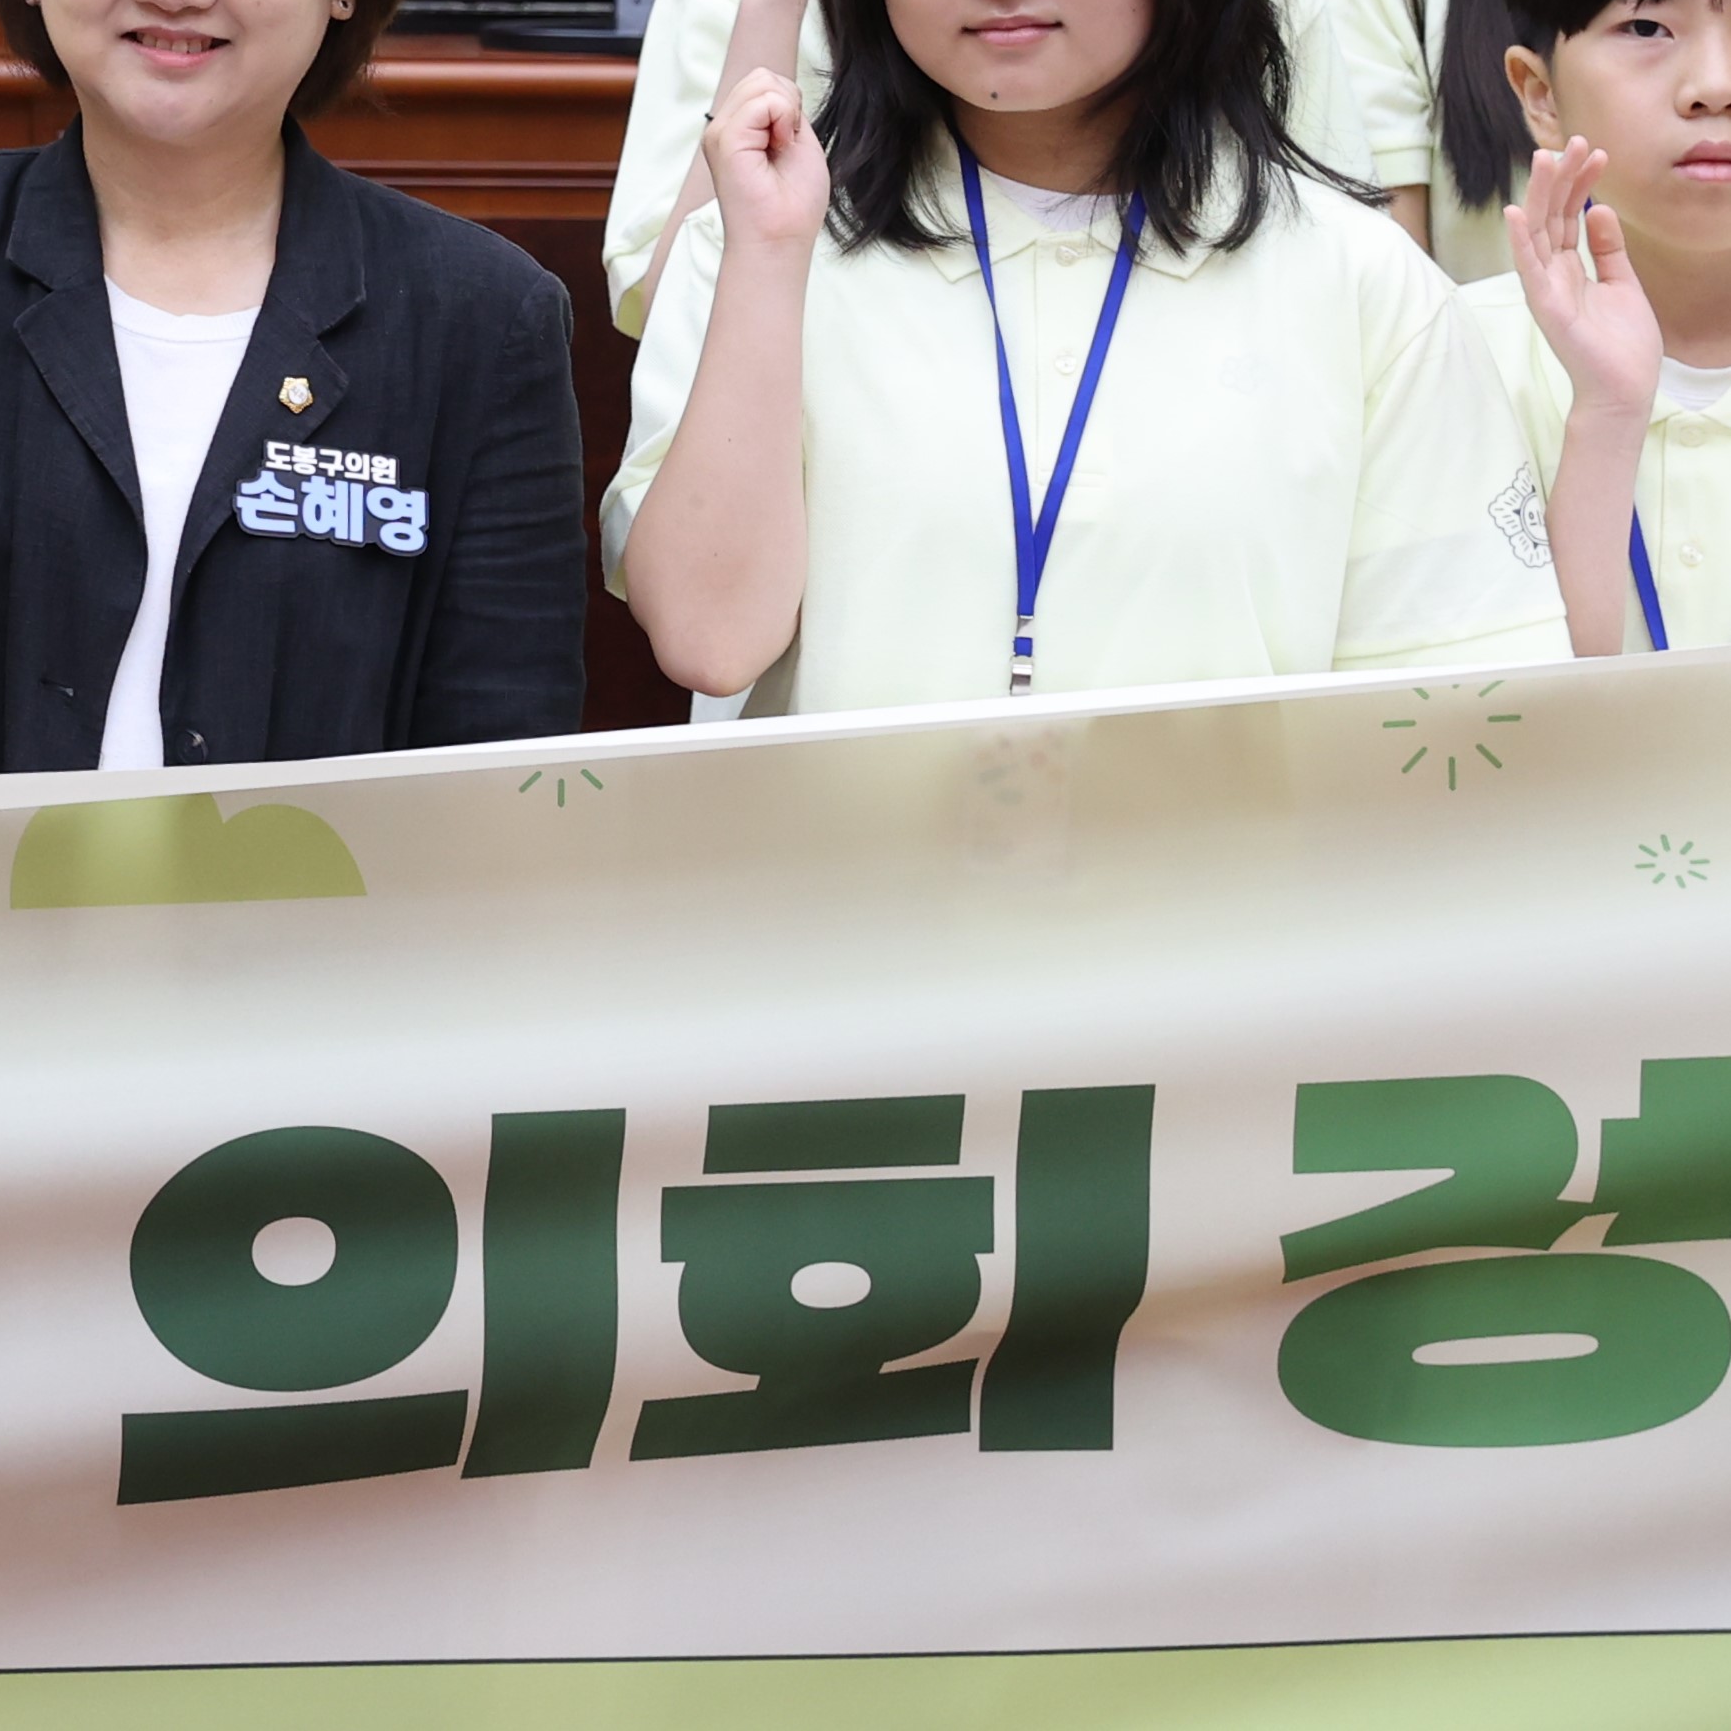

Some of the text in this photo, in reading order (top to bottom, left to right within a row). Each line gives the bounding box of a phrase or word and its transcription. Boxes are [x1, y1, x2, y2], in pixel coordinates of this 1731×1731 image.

[265, 440, 397, 485] 도봉구의원
[236, 470, 427, 553] 손혜영
[115, 1083, 1156, 1506] 의회
